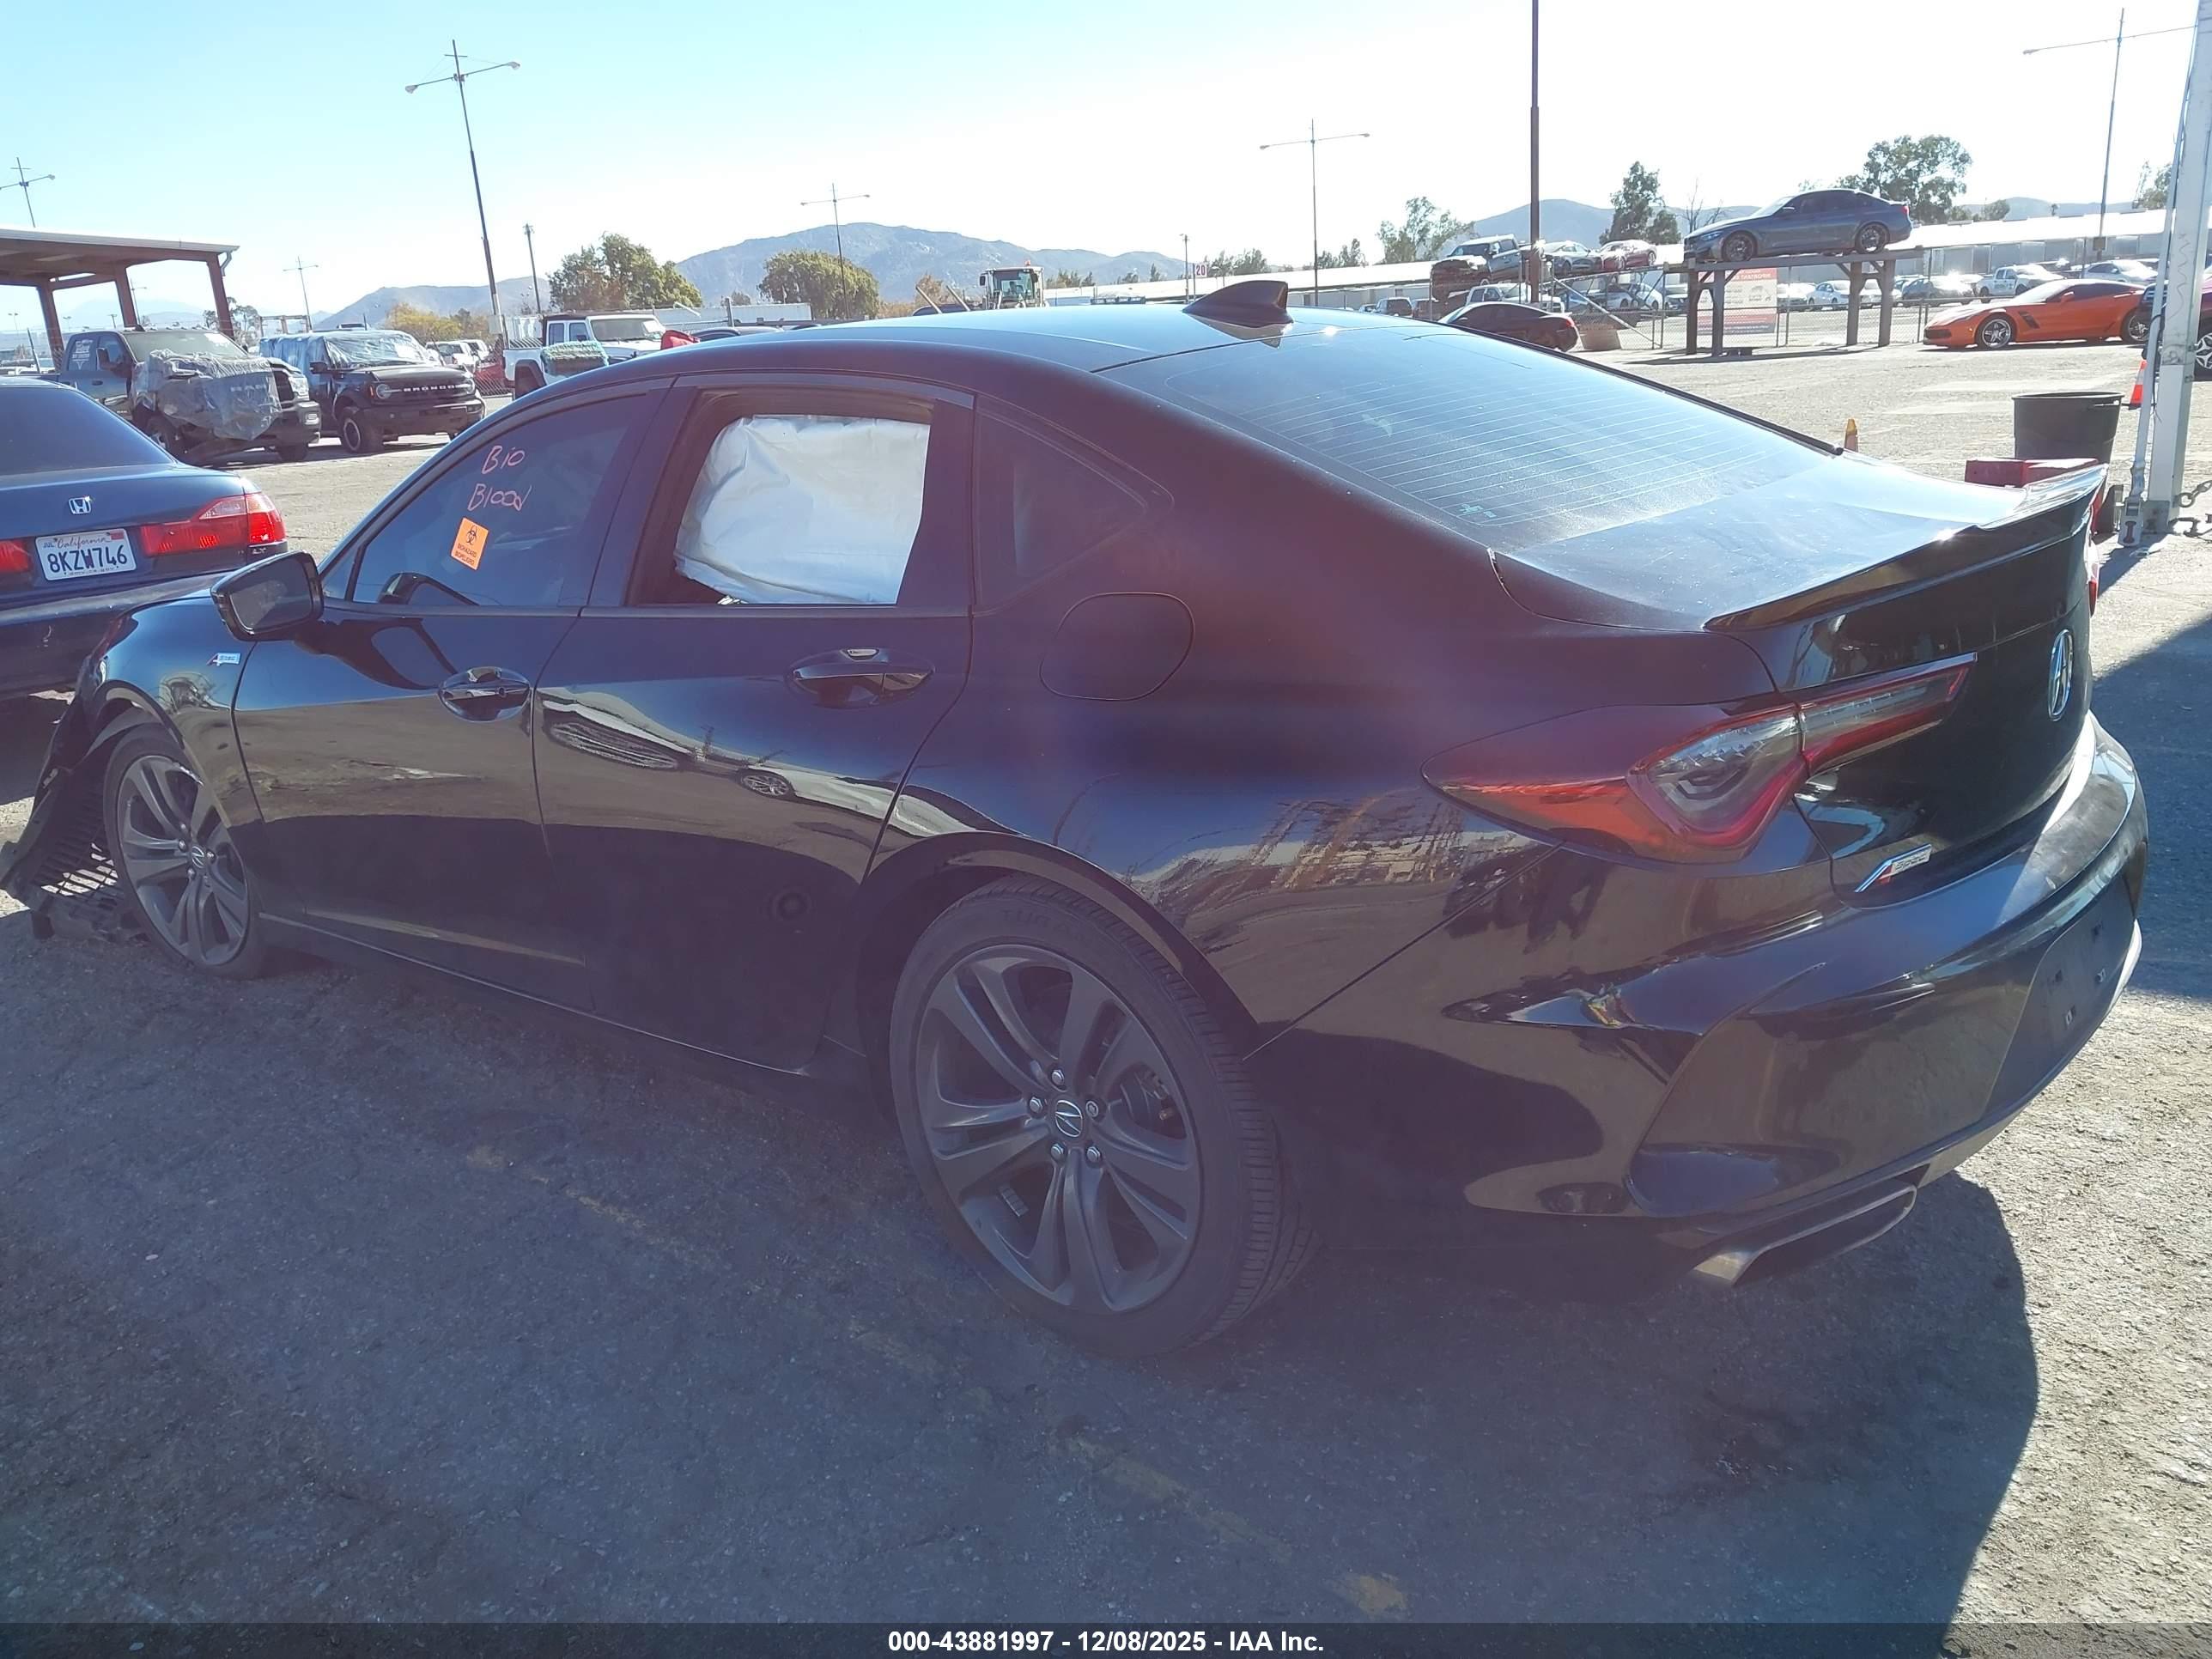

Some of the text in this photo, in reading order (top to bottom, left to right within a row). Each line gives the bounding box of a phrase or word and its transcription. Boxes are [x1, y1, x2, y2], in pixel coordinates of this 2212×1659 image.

[403, 384, 455, 392] BRONCO
[467, 483, 532, 511] Blood
[57, 536, 112, 550] California
[47, 544, 127, 573] 8KZW746
